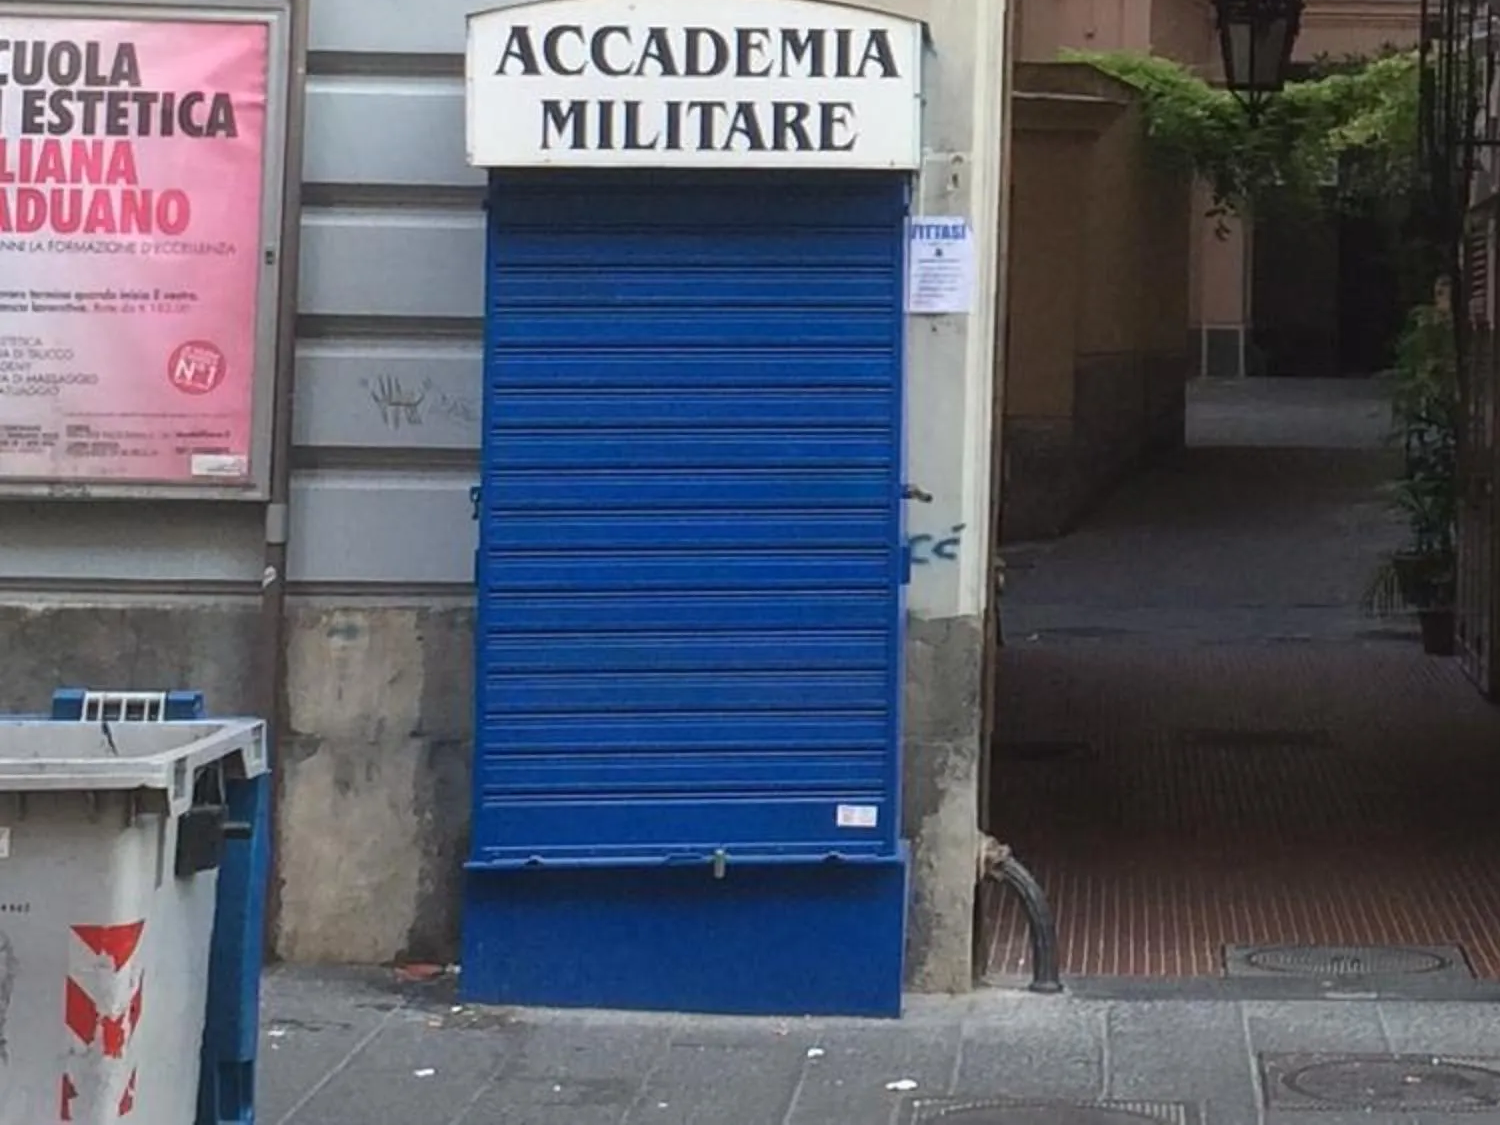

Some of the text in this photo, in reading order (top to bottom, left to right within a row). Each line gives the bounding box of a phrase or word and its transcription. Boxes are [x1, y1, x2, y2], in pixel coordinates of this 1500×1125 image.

[494, 24, 902, 78] ACCADEMIA
[21, 89, 238, 138] ESTETICA
[540, 99, 857, 151] MILITARE
[0, 138, 138, 186] LIANA
[29, 240, 45, 254] LA
[47, 239, 137, 255] FORMAZIONE
